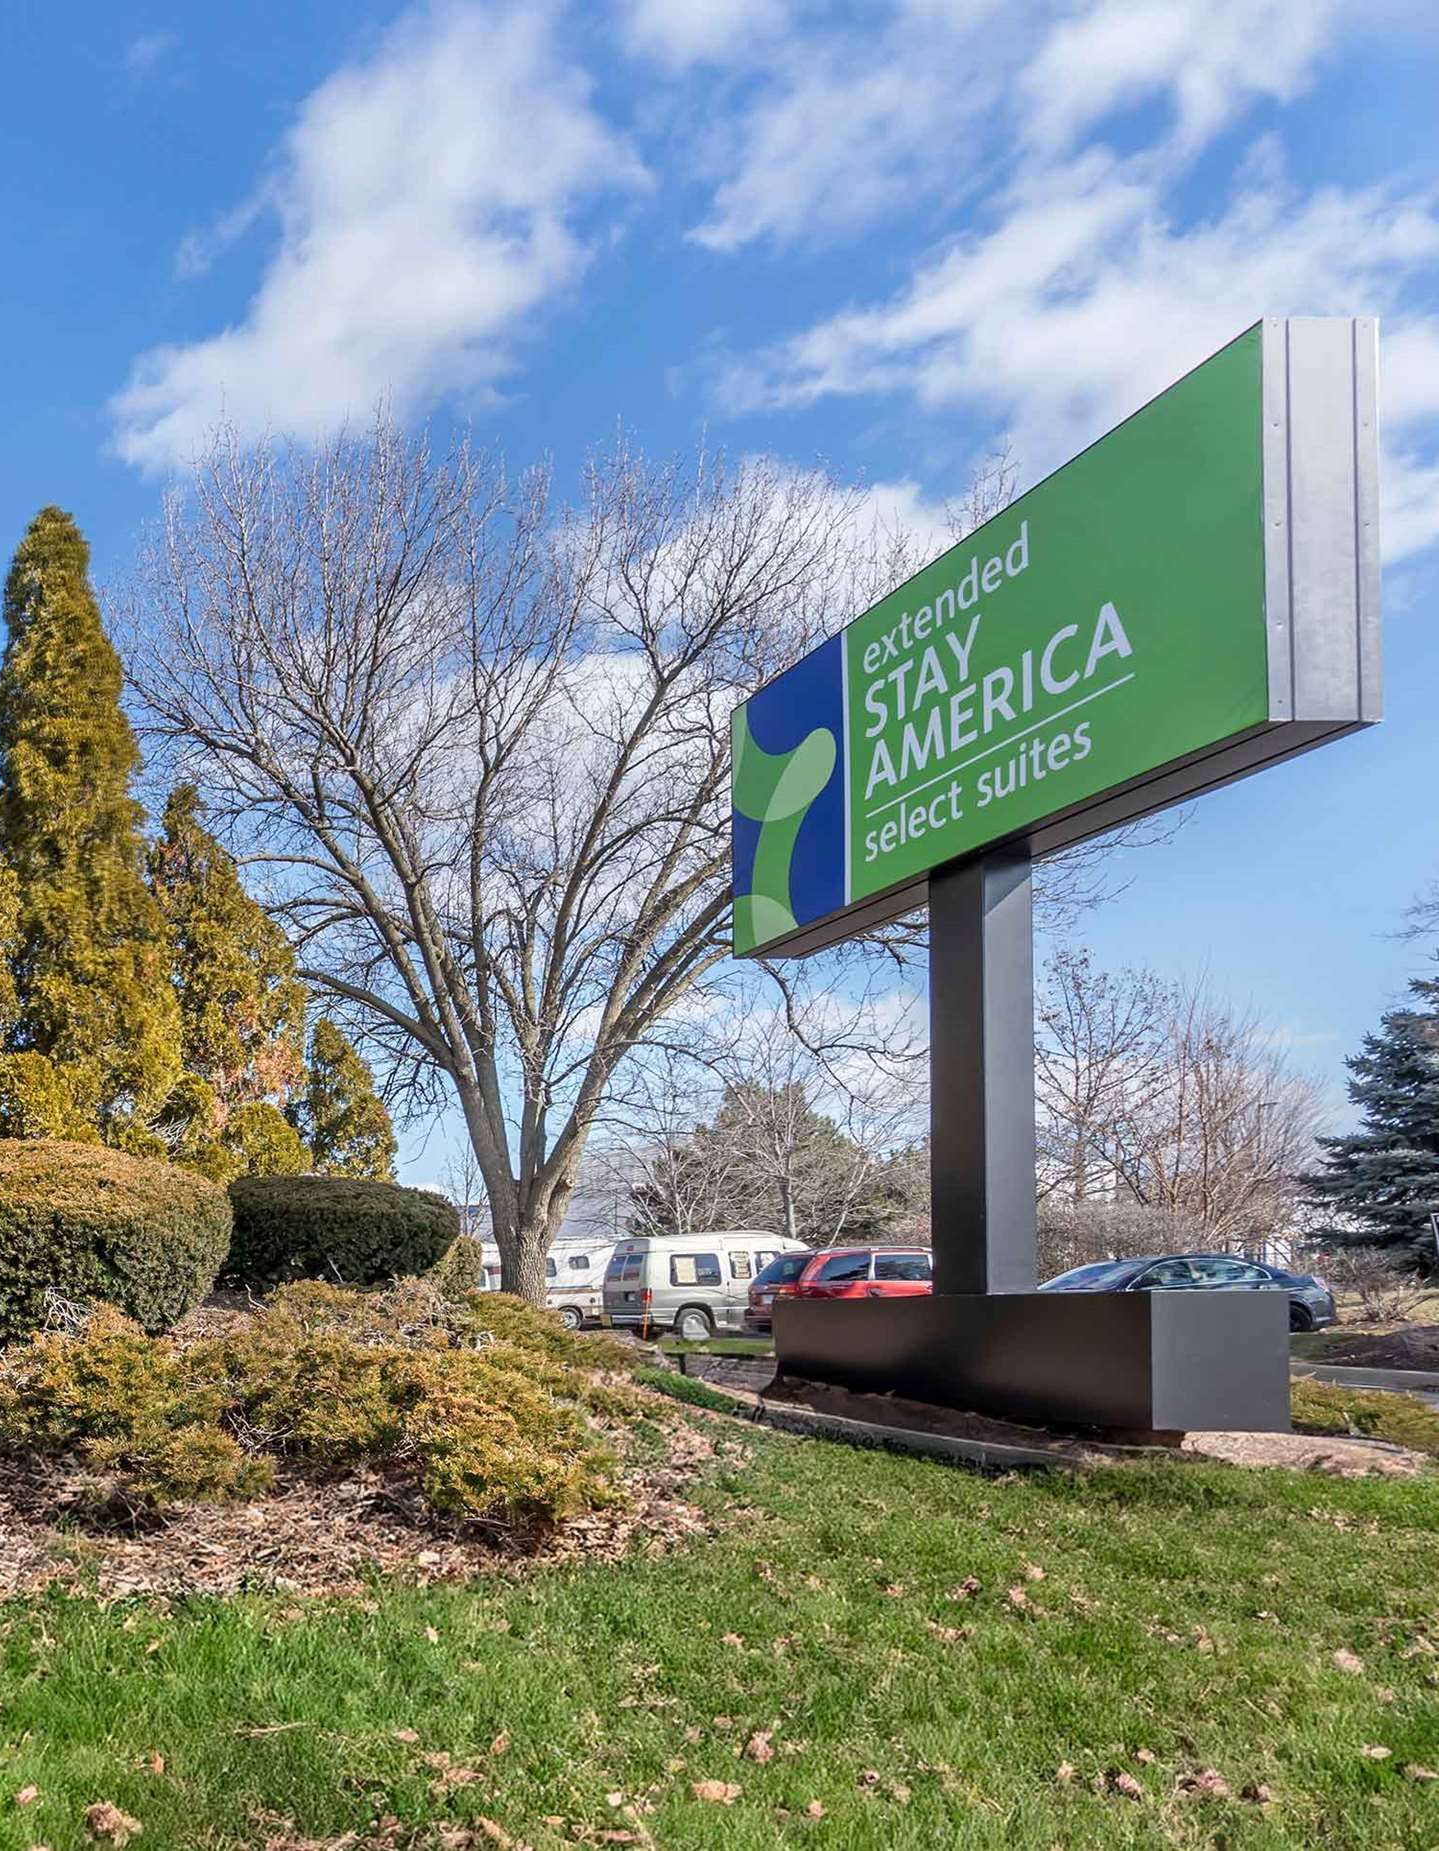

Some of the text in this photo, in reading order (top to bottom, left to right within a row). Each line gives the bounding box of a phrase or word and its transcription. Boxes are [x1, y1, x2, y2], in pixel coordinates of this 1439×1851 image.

[863, 520, 1030, 674] extended
[865, 614, 981, 738] STAY
[865, 601, 1133, 800] AMERICA
[865, 721, 1092, 863] select suites
